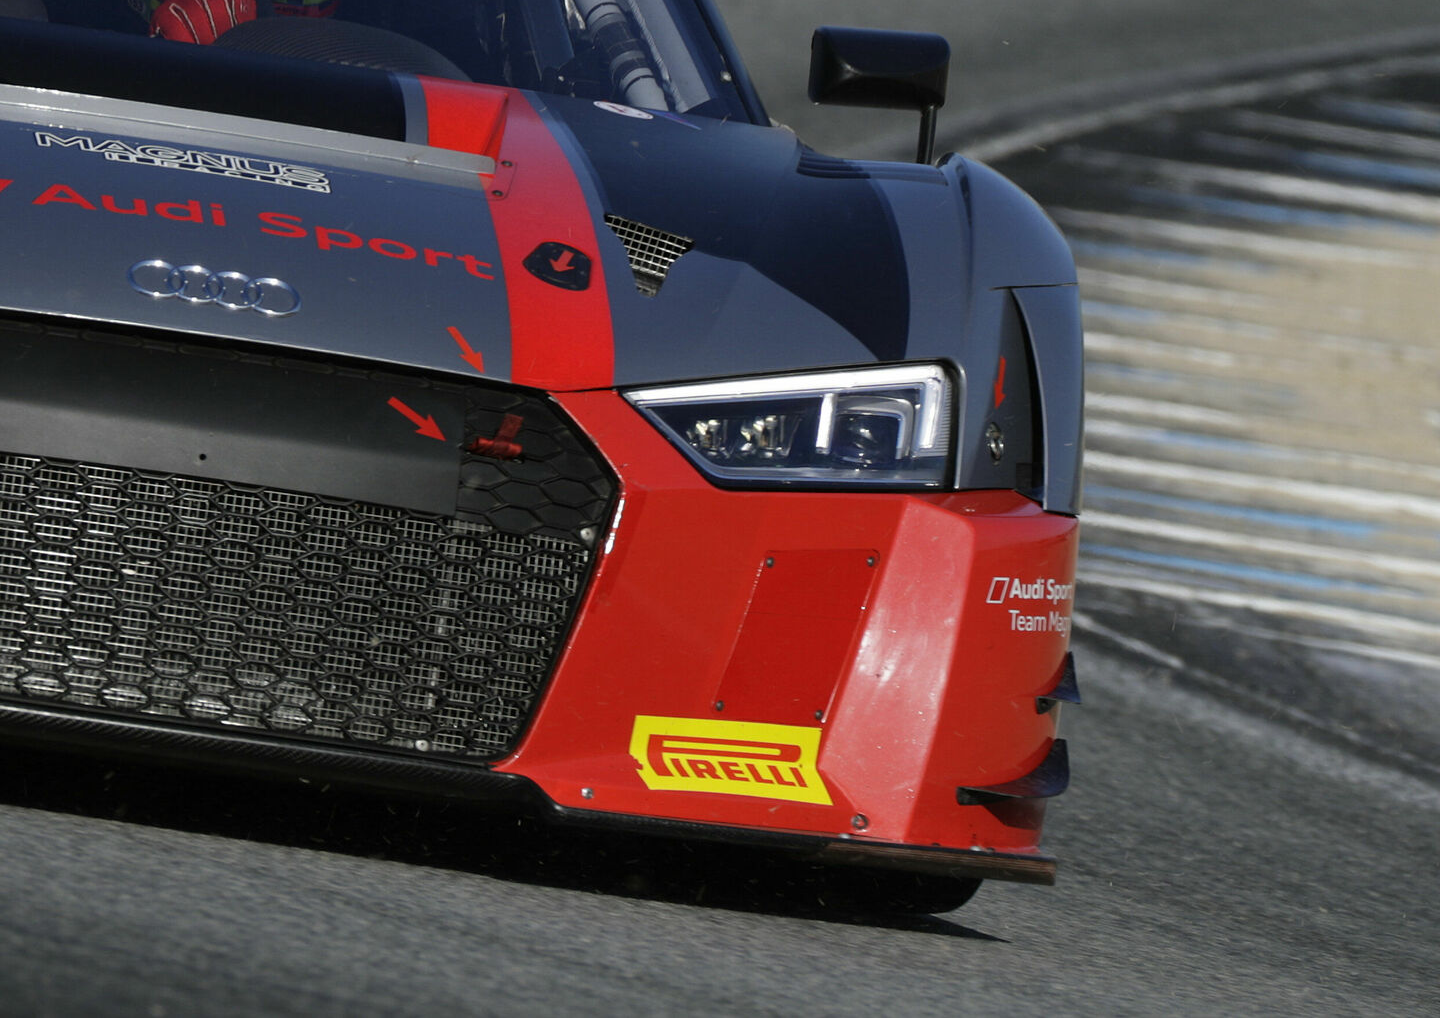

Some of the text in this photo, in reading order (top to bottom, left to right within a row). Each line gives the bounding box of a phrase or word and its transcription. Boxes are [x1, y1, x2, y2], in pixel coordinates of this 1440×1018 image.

[35, 131, 330, 187] MAGNUS
[31, 183, 495, 281] Audi Sport
[1009, 577, 1073, 606] Audi Spor
[1008, 609, 1047, 632] Team
[646, 734, 809, 788] PIRELLI
